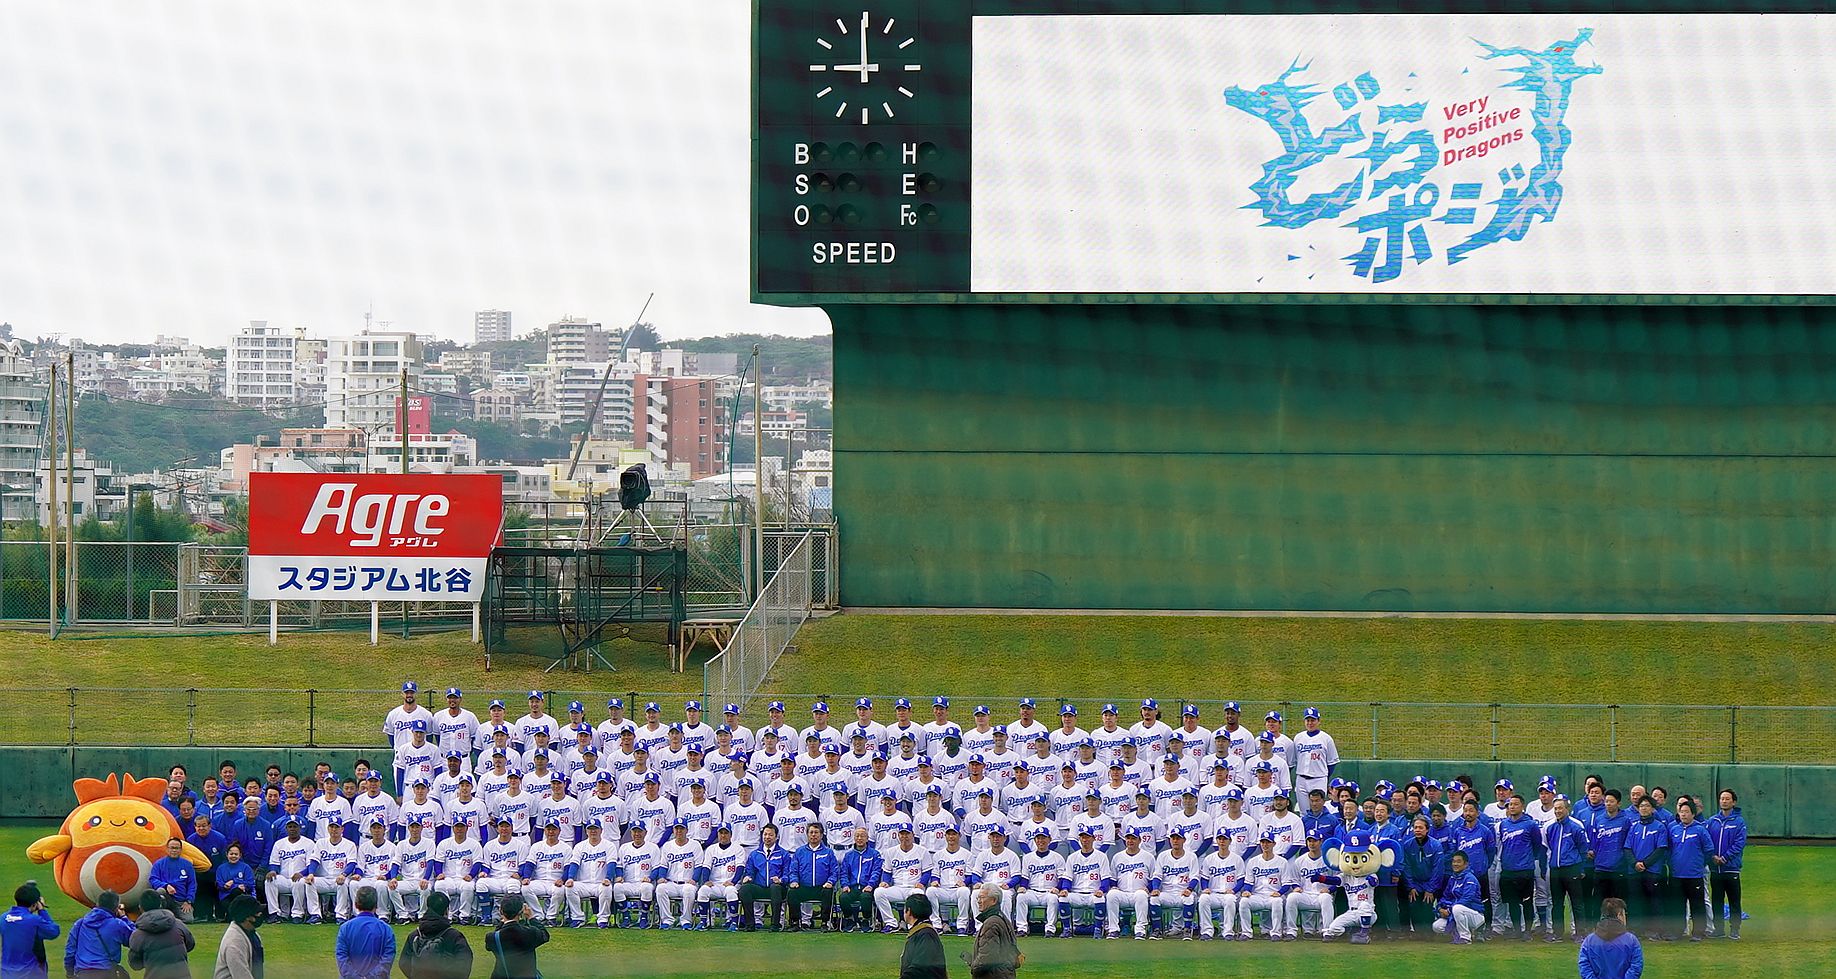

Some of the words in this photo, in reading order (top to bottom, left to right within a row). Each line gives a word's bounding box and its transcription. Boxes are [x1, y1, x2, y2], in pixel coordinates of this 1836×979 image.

[1443, 94, 1490, 121] Very
[1443, 105, 1521, 144] Positive
[795, 144, 809, 165] B
[902, 143, 917, 164] H
[1443, 128, 1524, 167] Dragons
[795, 173, 809, 195] S
[902, 173, 916, 195] E
[900, 204, 917, 226] Fc
[812, 242, 896, 264] SPEED
[301, 483, 450, 547] Agre
[389, 537, 438, 548] アグレ
[278, 565, 472, 593] スタジアム北谷
[457, 732, 465, 740] 91
[560, 816, 569, 825] 50
[605, 815, 614, 823] 20
[796, 825, 805, 833] 33
[1236, 835, 1246, 843] 57
[1135, 871, 1144, 880] 78
[1269, 877, 1279, 885] 72
